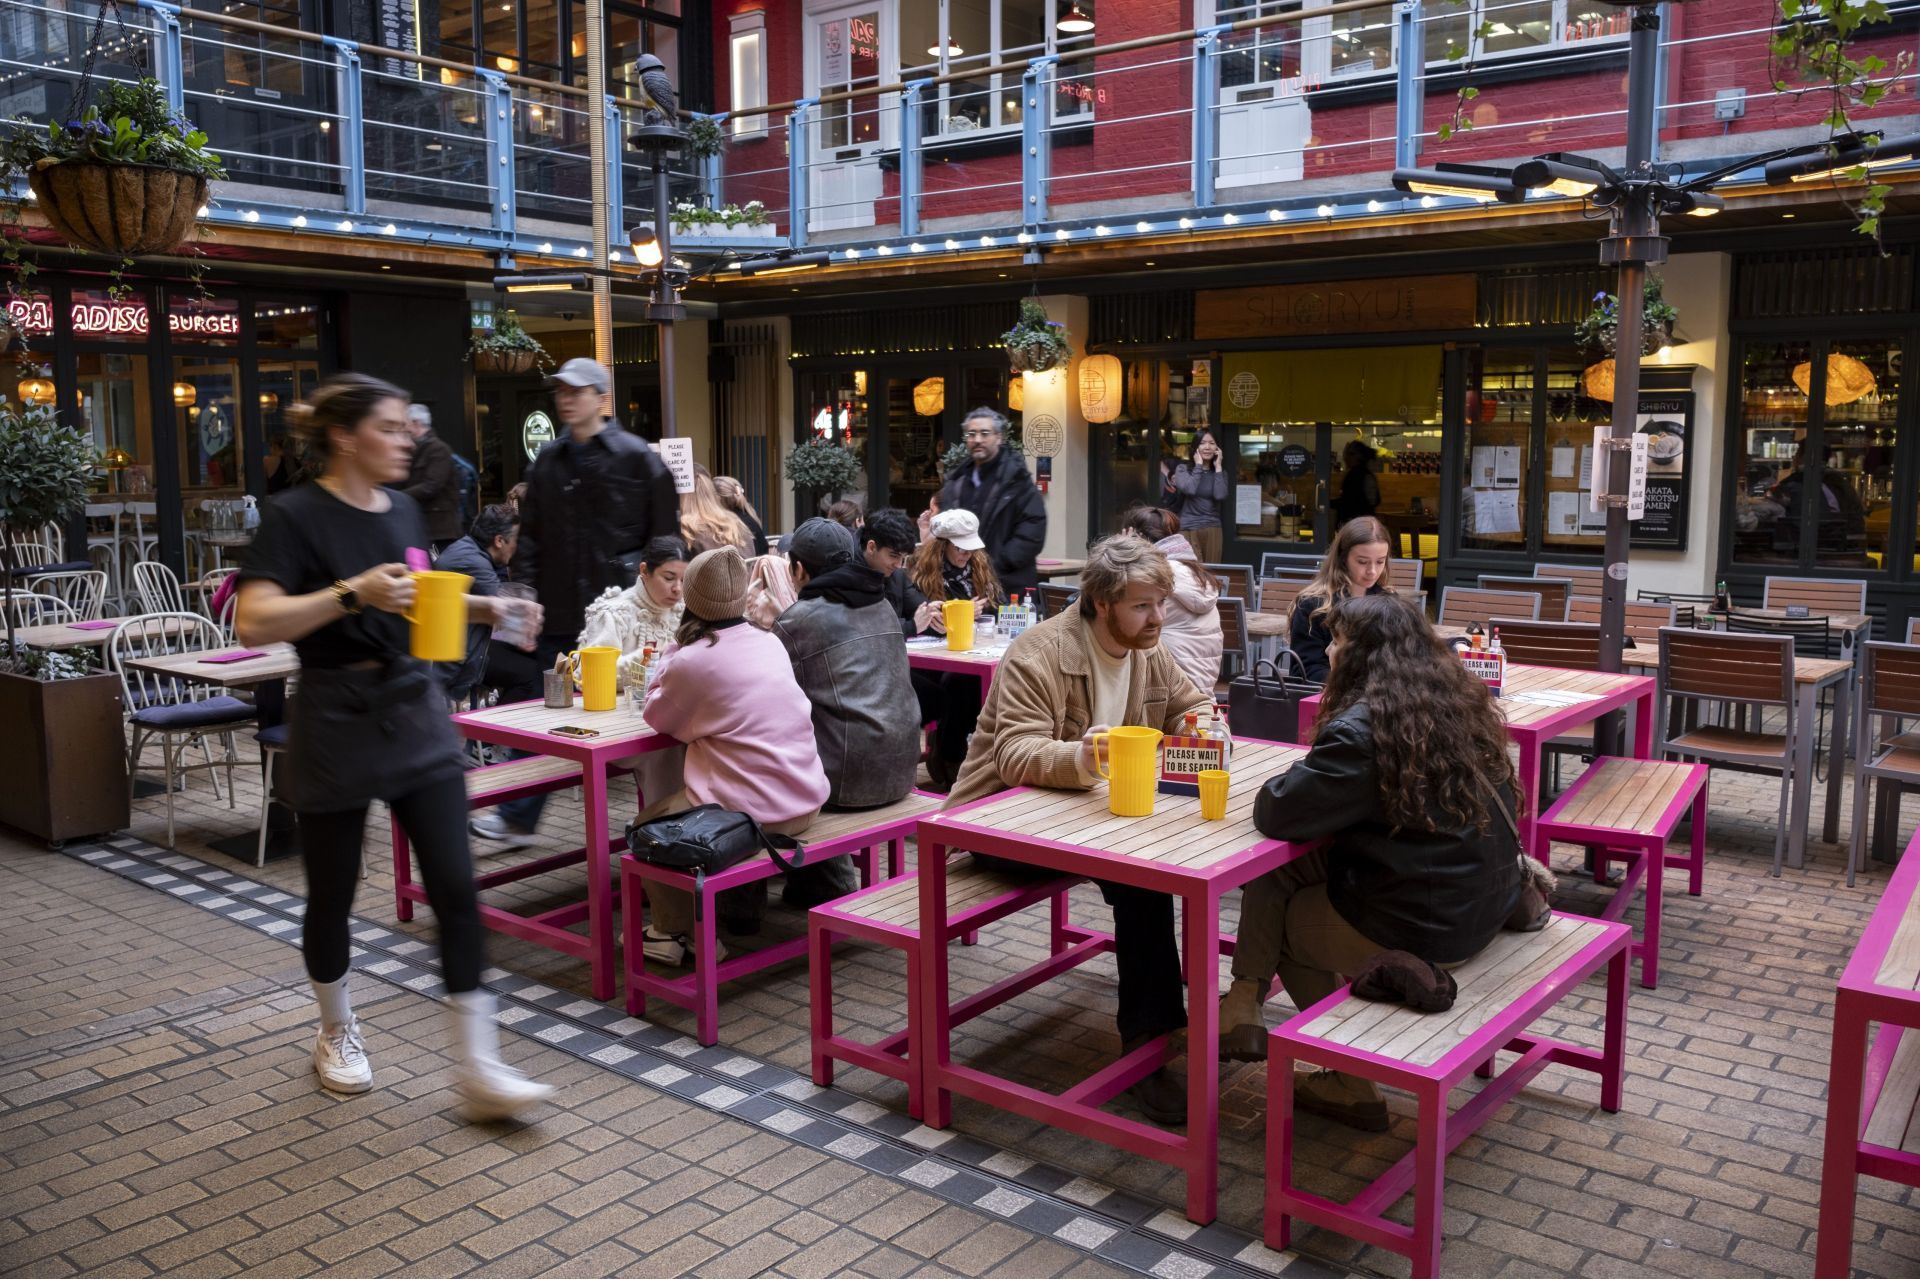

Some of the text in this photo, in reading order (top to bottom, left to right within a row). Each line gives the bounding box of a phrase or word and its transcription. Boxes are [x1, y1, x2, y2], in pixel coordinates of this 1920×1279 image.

[1247, 287, 1401, 326] SHORYU
[1641, 402, 1679, 411] SHORYU
[1645, 487, 1673, 495] AKATA
[1644, 494, 1679, 502] NKOTSU
[1645, 501, 1671, 510] AMEN
[1167, 749, 1218, 760] PLEASE WAIT
[1166, 762, 1175, 771] TO
[1178, 763, 1187, 772] BE
